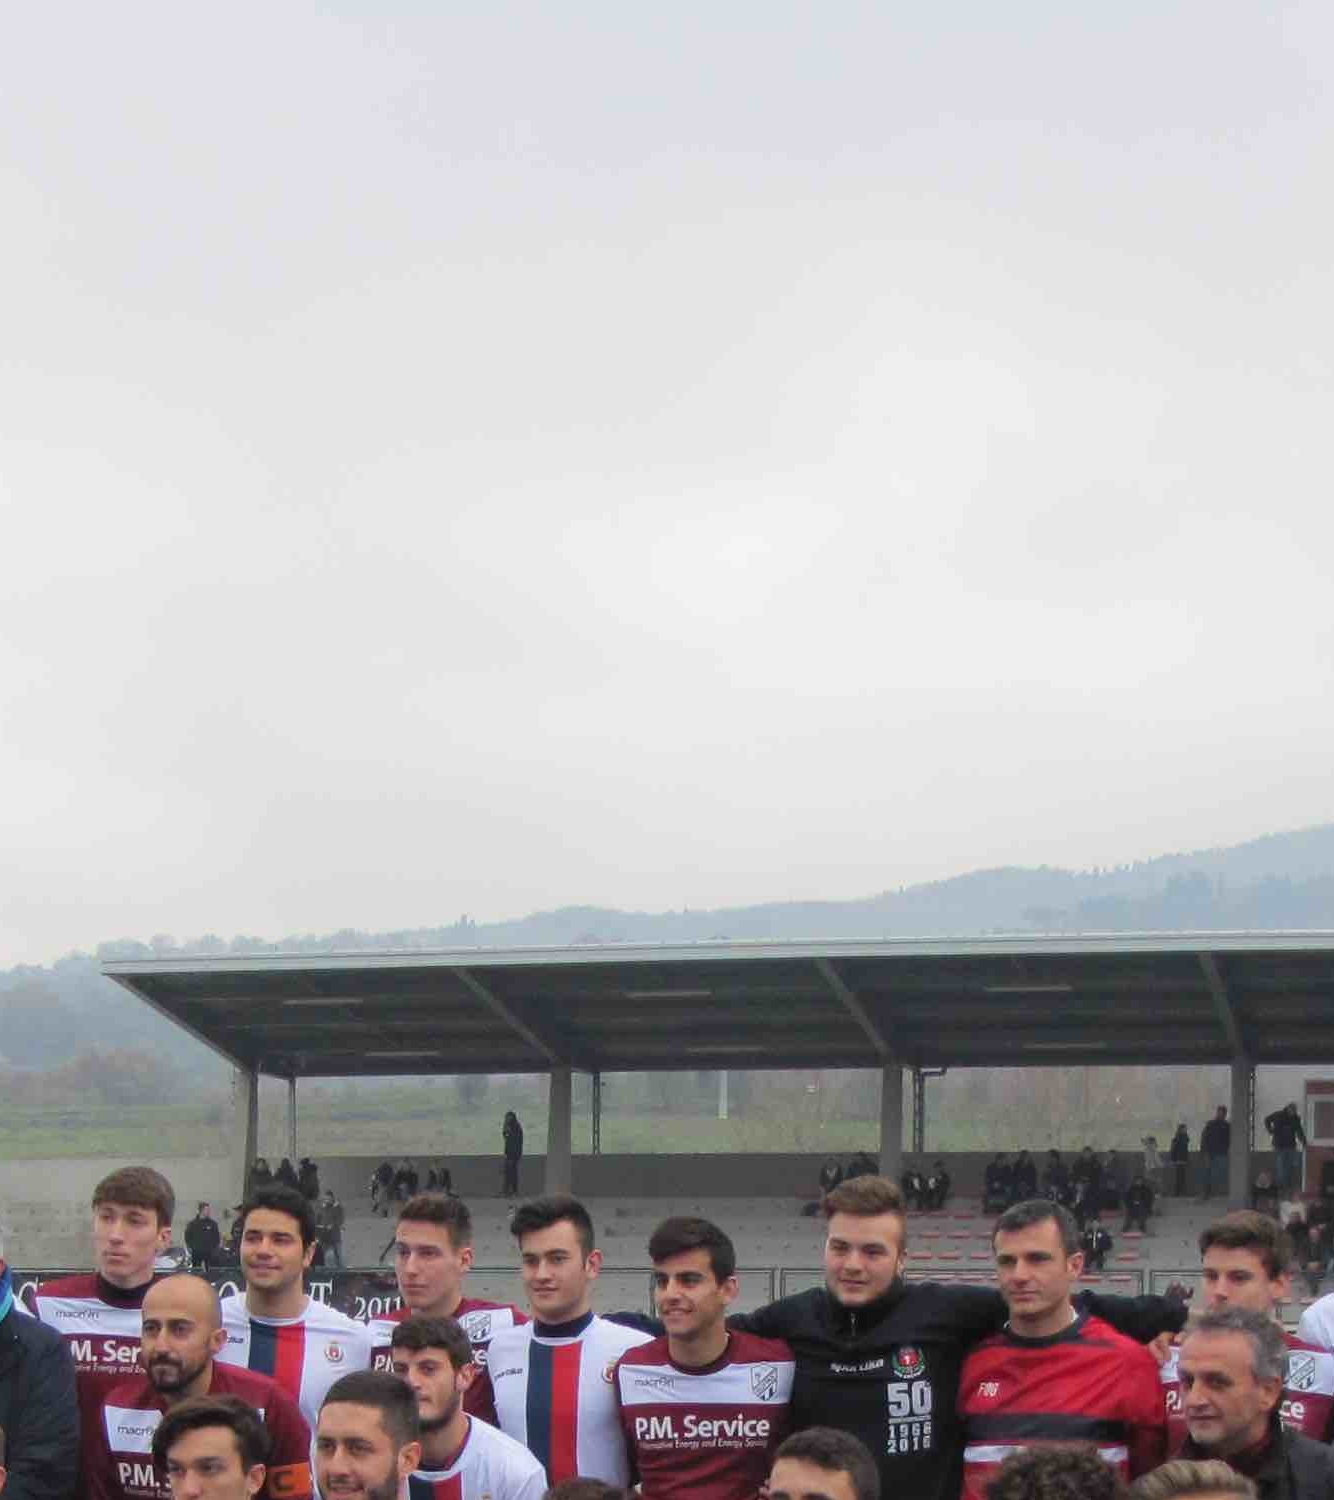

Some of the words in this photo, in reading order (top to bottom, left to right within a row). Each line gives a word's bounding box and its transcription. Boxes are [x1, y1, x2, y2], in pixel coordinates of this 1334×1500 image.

[635, 1416, 679, 1440] P.M.
[683, 1413, 770, 1438] Service
[118, 1462, 160, 1488] P.M.
